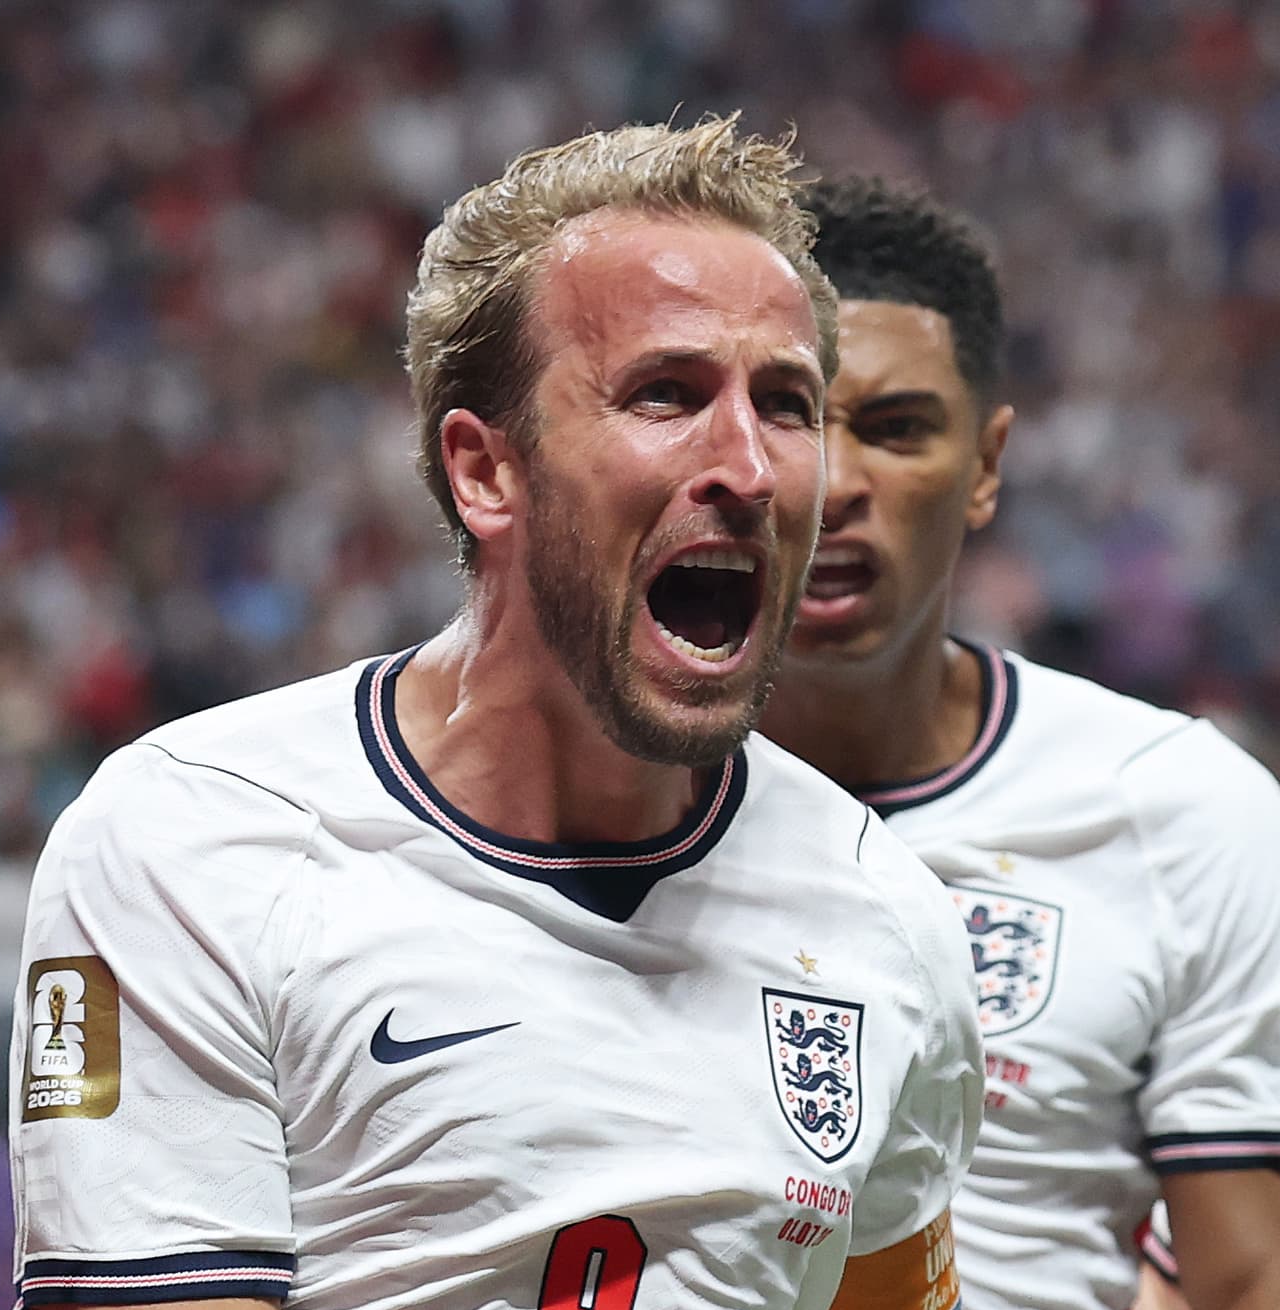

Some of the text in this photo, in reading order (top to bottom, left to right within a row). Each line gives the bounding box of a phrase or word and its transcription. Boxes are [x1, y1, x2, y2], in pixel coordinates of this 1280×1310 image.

[40, 1055, 69, 1066] FIFA
[29, 1078, 84, 1091] WORLD CUP
[27, 1090, 83, 1110] 2026
[784, 1175, 837, 1213] CONGO
